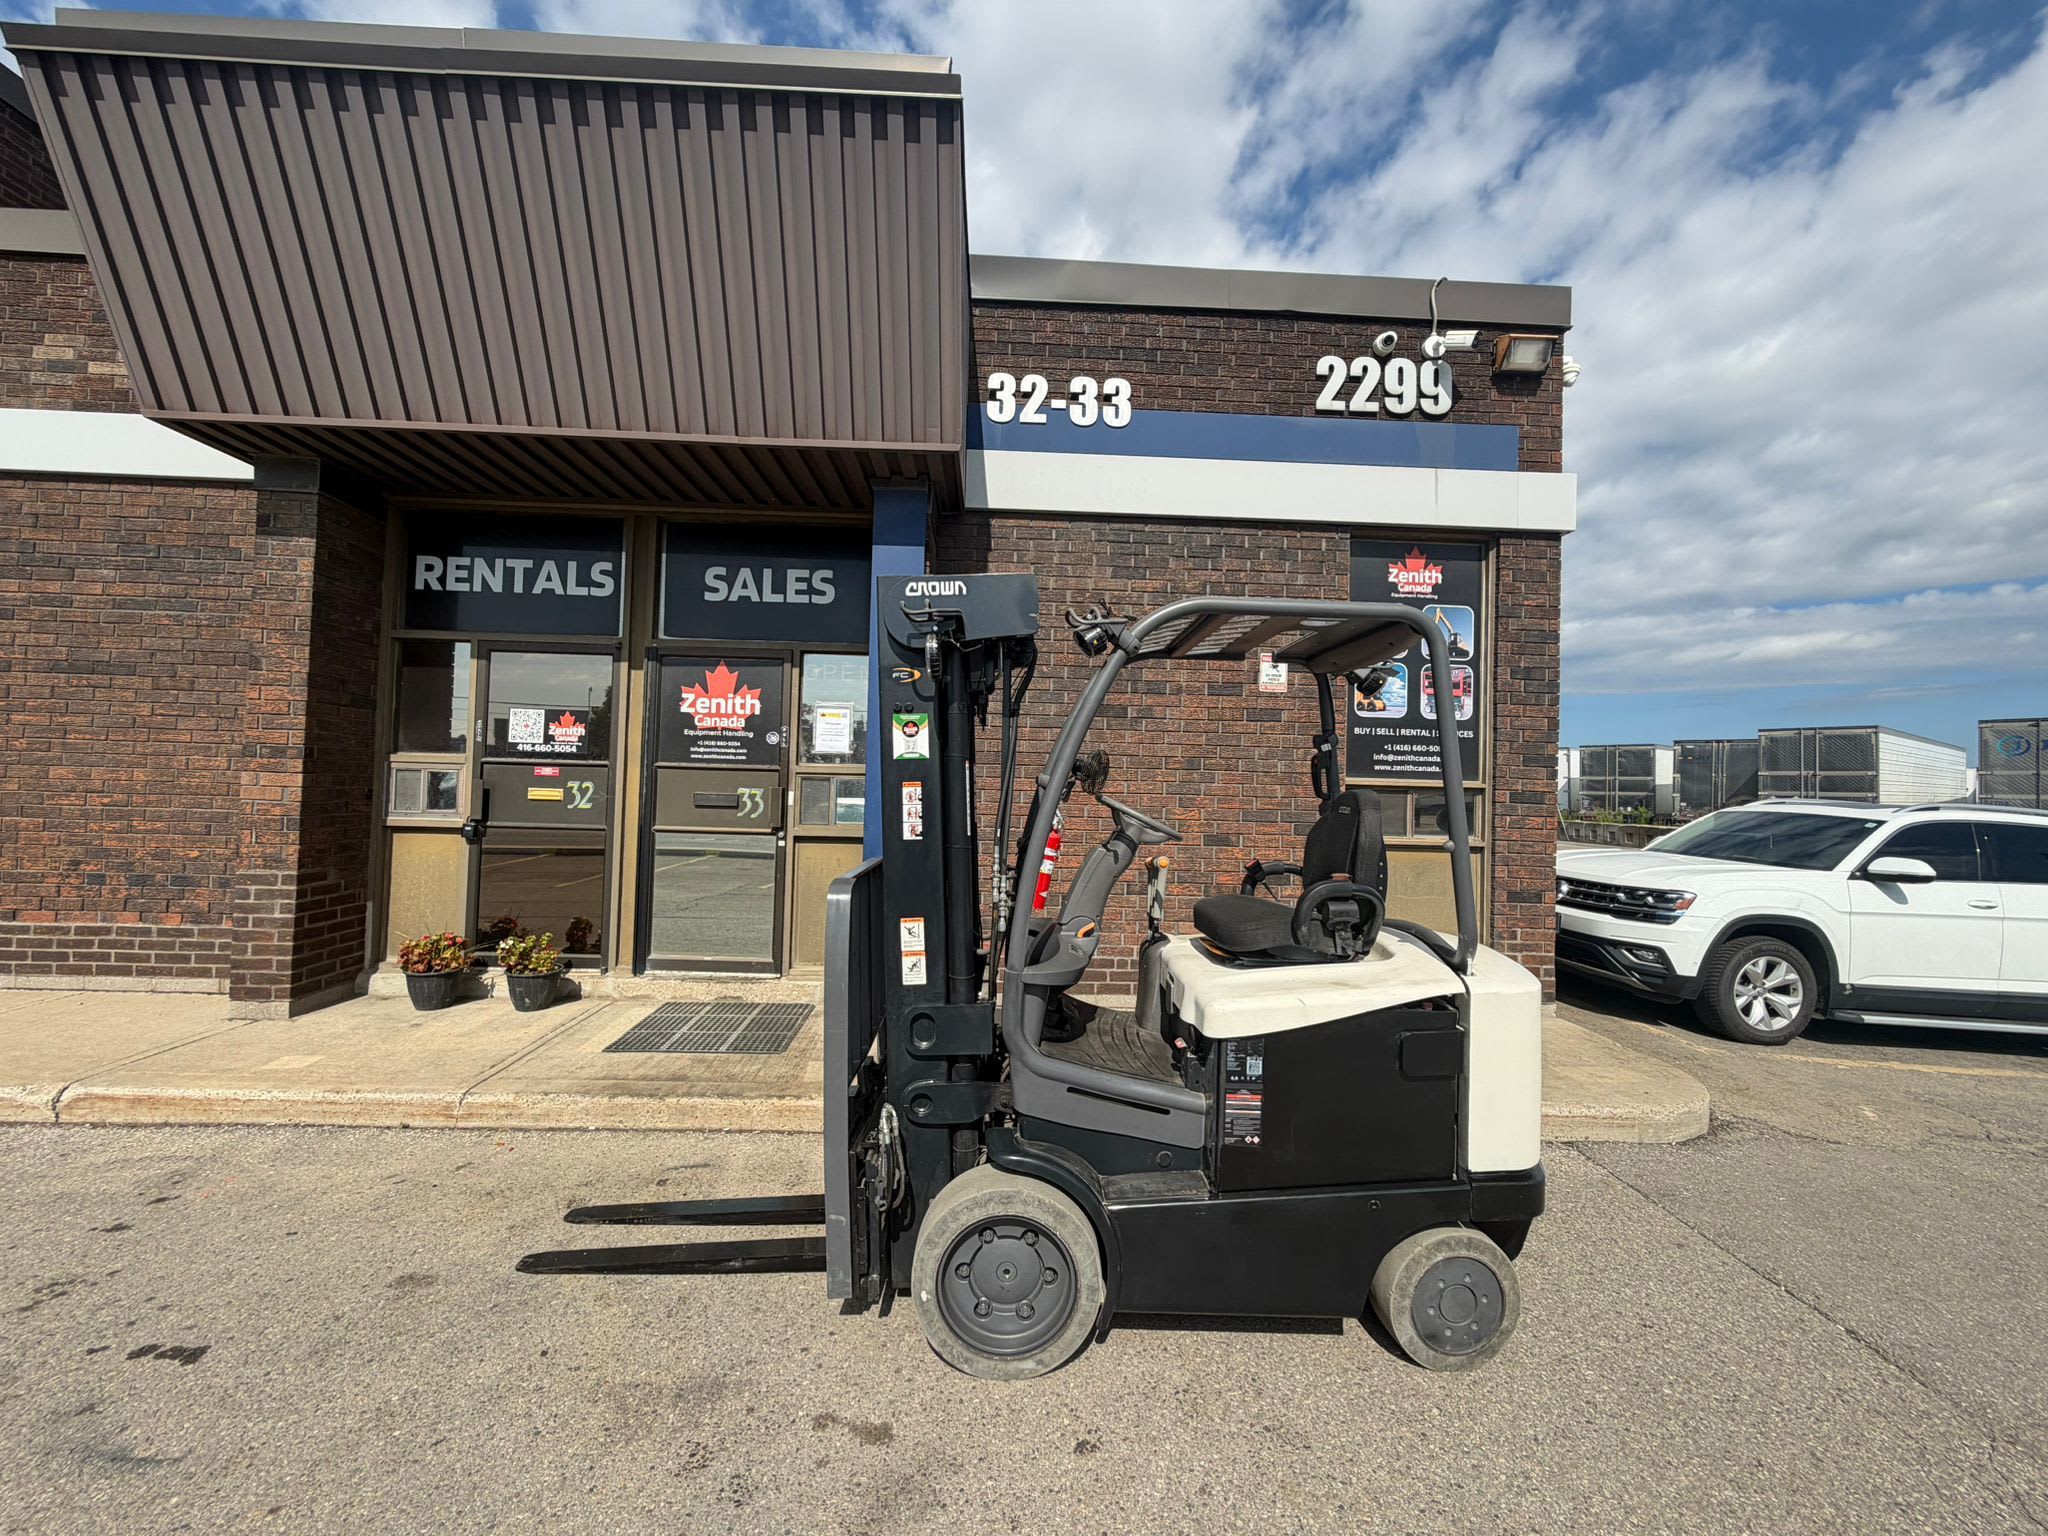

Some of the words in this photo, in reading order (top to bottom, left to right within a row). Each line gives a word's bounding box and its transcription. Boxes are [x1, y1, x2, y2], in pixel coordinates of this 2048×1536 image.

[1315, 355, 1453, 415] 2299
[986, 372, 1132, 428] 32-33
[414, 555, 615, 597] RENTALS
[1388, 568, 1443, 584] Zenith
[703, 566, 836, 604] SALES
[1397, 583, 1433, 593] Canada
[892, 671, 909, 679] FC
[680, 692, 761, 715] Zenith
[694, 714, 746, 728] Canada
[548, 725, 586, 736] Zenith
[683, 728, 721, 738] Equipment
[723, 730, 754, 738] Handling
[1354, 727, 1371, 735] BUY
[1376, 728, 1395, 736] SELL
[1400, 728, 1431, 737] RENTAL
[555, 734, 579, 742] Canada
[517, 743, 577, 753] 416-660-5054
[1393, 743, 1411, 752] (416)
[1412, 744, 1440, 752] 660-50
[1373, 753, 1441, 763] info@zenithcanada.
[1374, 764, 1442, 773] www.zenithcanada.
[566, 780, 595, 810] 32
[736, 787, 765, 819] 33
